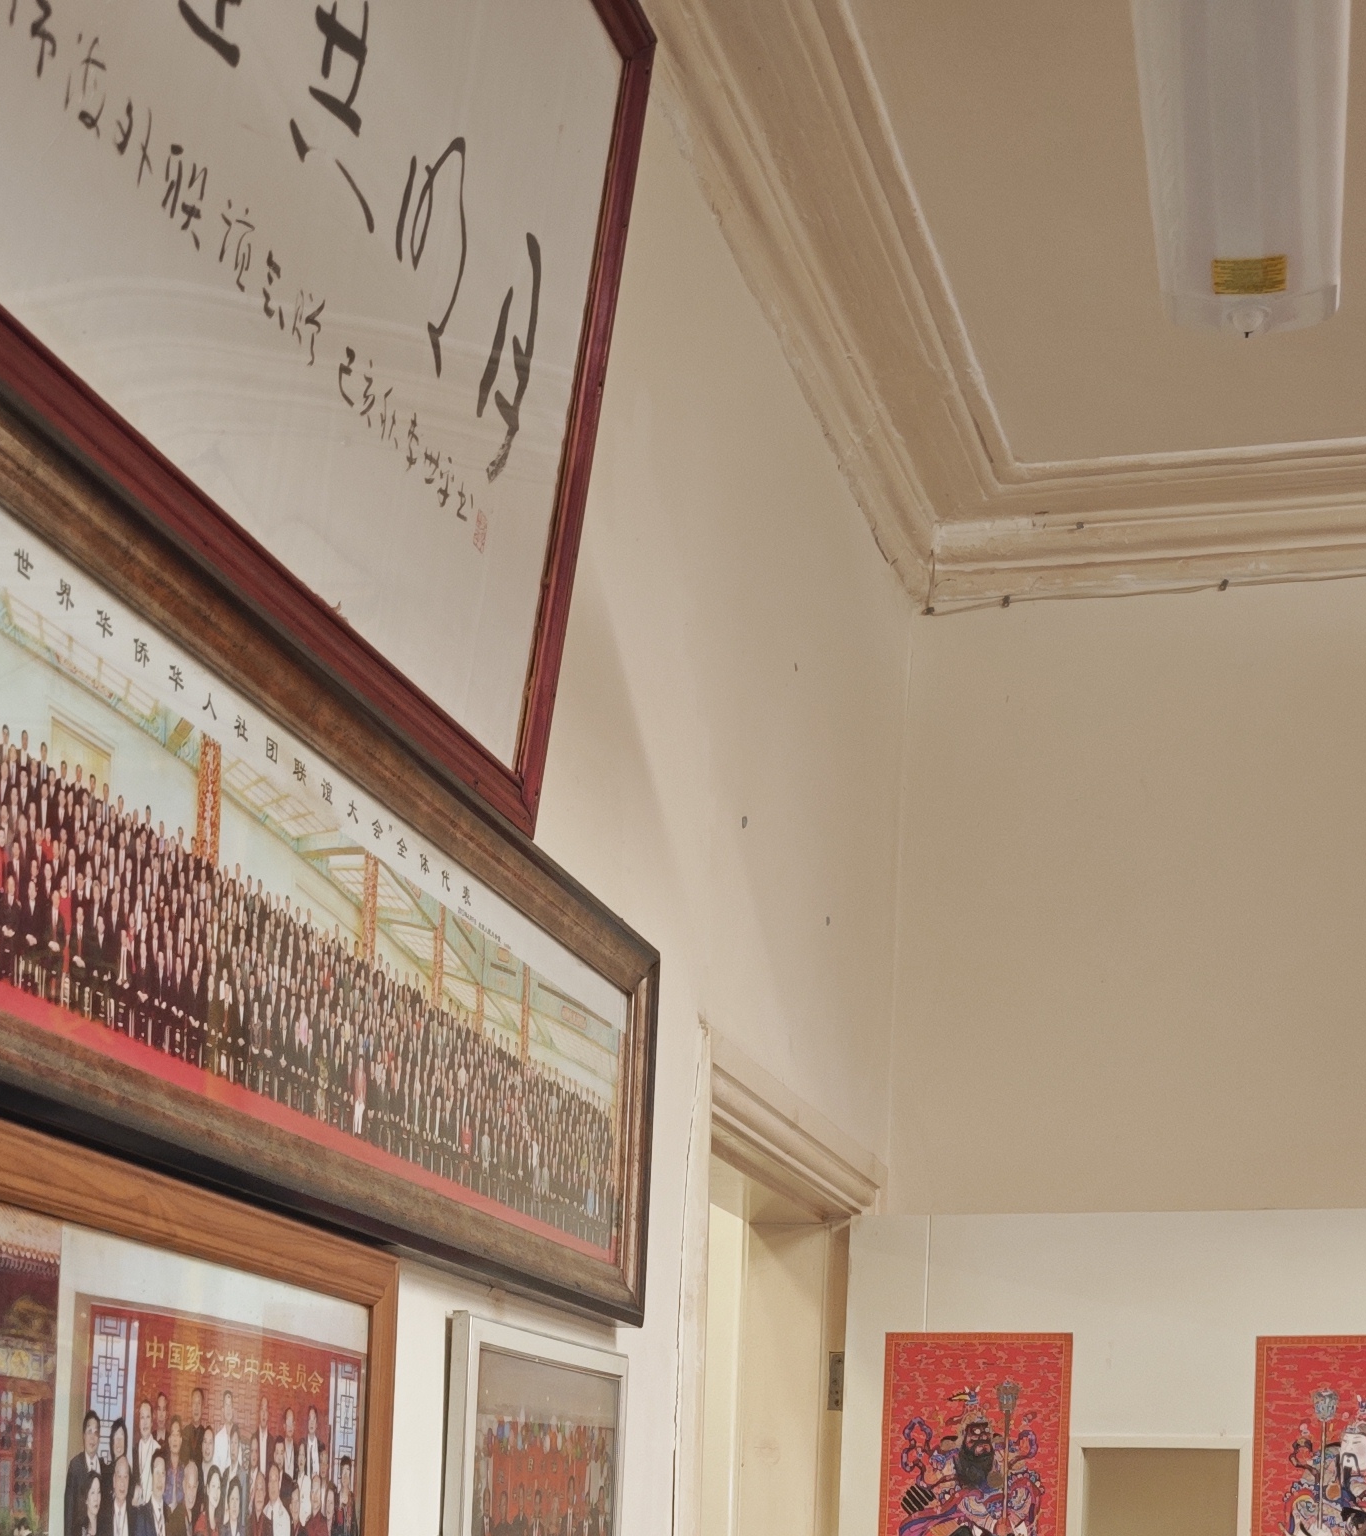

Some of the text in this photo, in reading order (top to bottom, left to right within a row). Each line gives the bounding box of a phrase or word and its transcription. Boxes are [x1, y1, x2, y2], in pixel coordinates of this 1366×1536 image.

[144, 1336, 325, 1395] 中国致公党中央委员会
